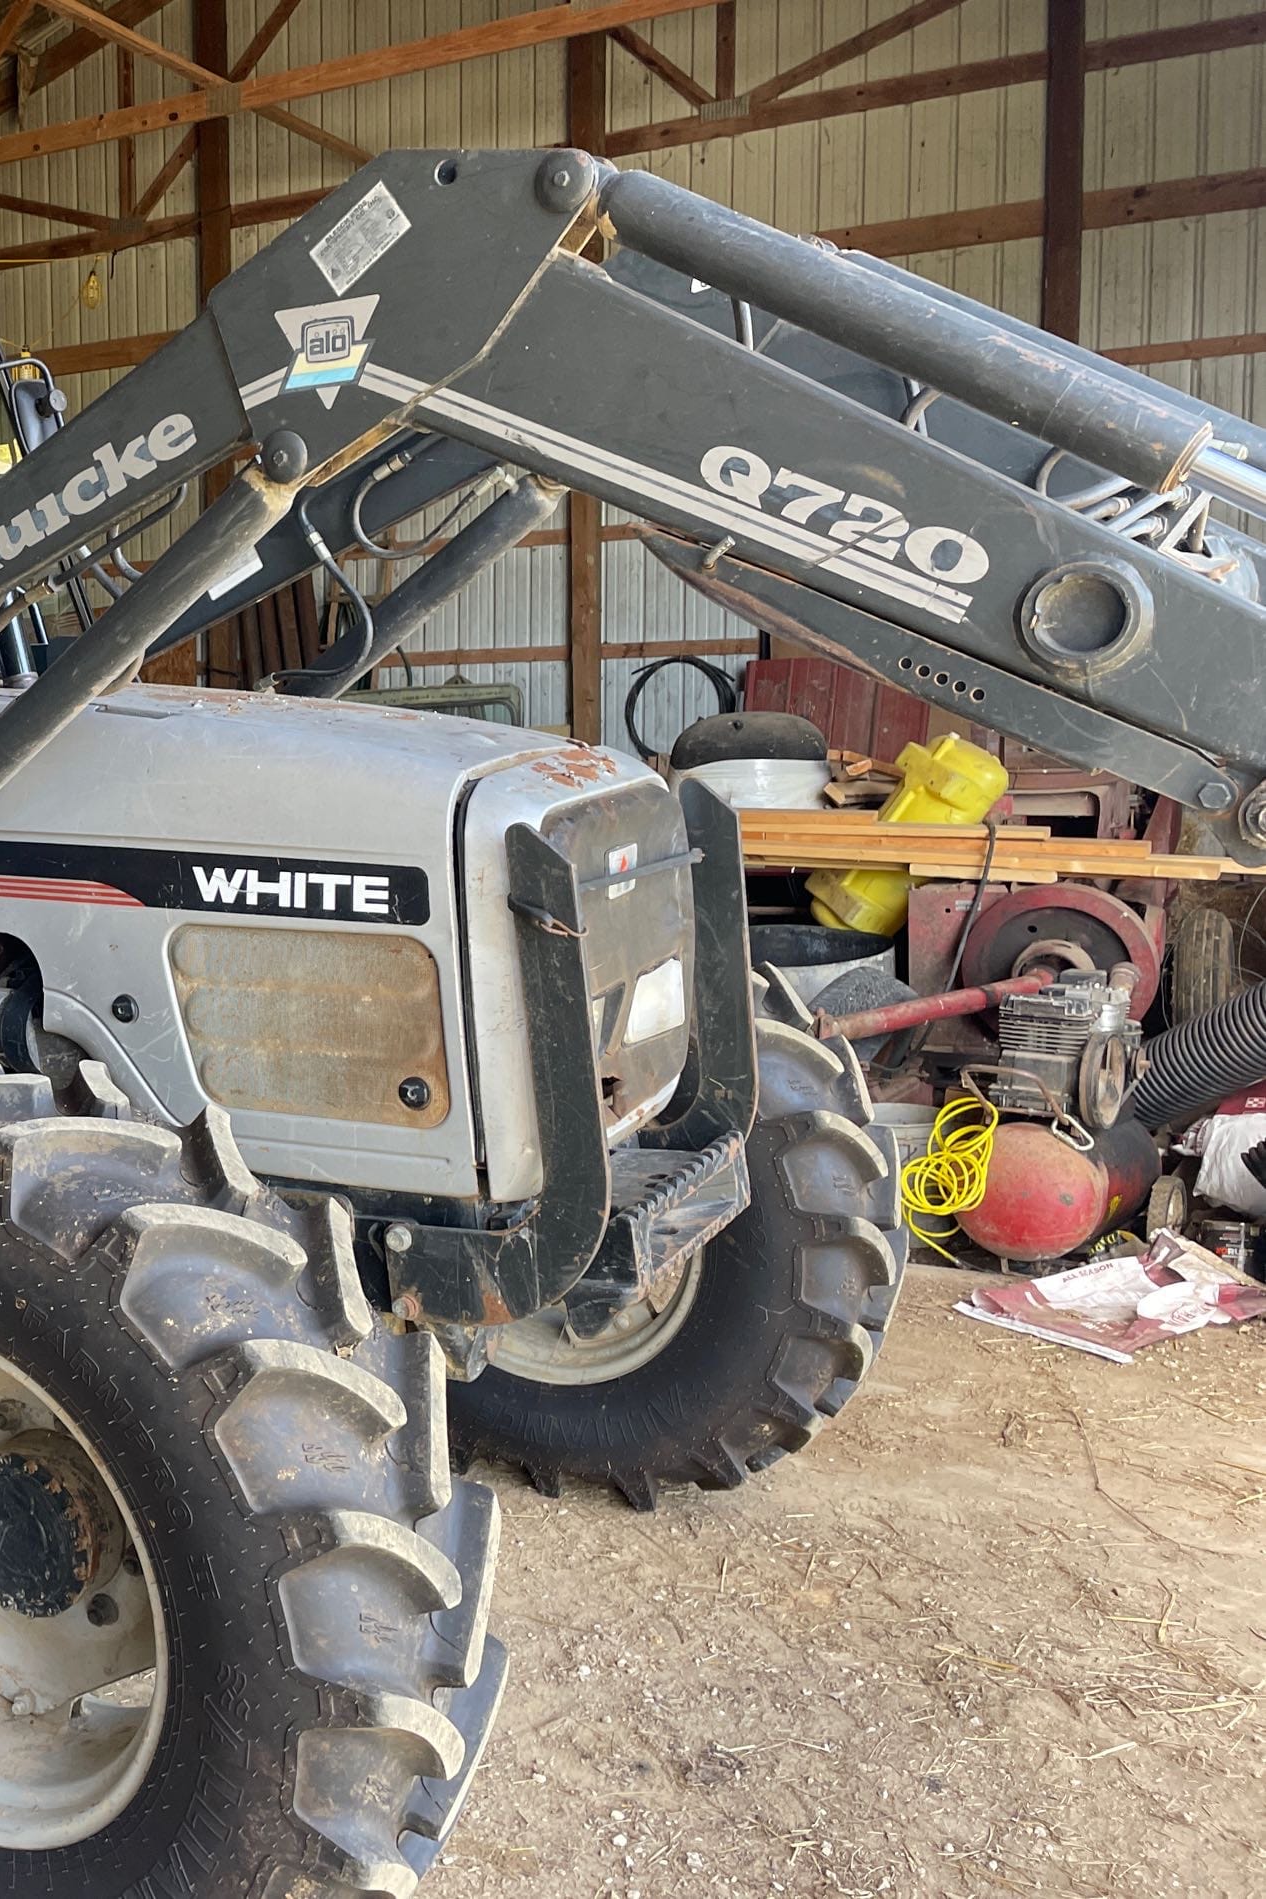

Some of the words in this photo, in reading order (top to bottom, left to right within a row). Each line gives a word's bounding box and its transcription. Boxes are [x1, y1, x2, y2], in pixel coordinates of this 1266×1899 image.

[700, 445, 990, 584] Q720
[192, 865, 390, 914] WHITE
[1062, 1273, 1079, 1283] ALL
